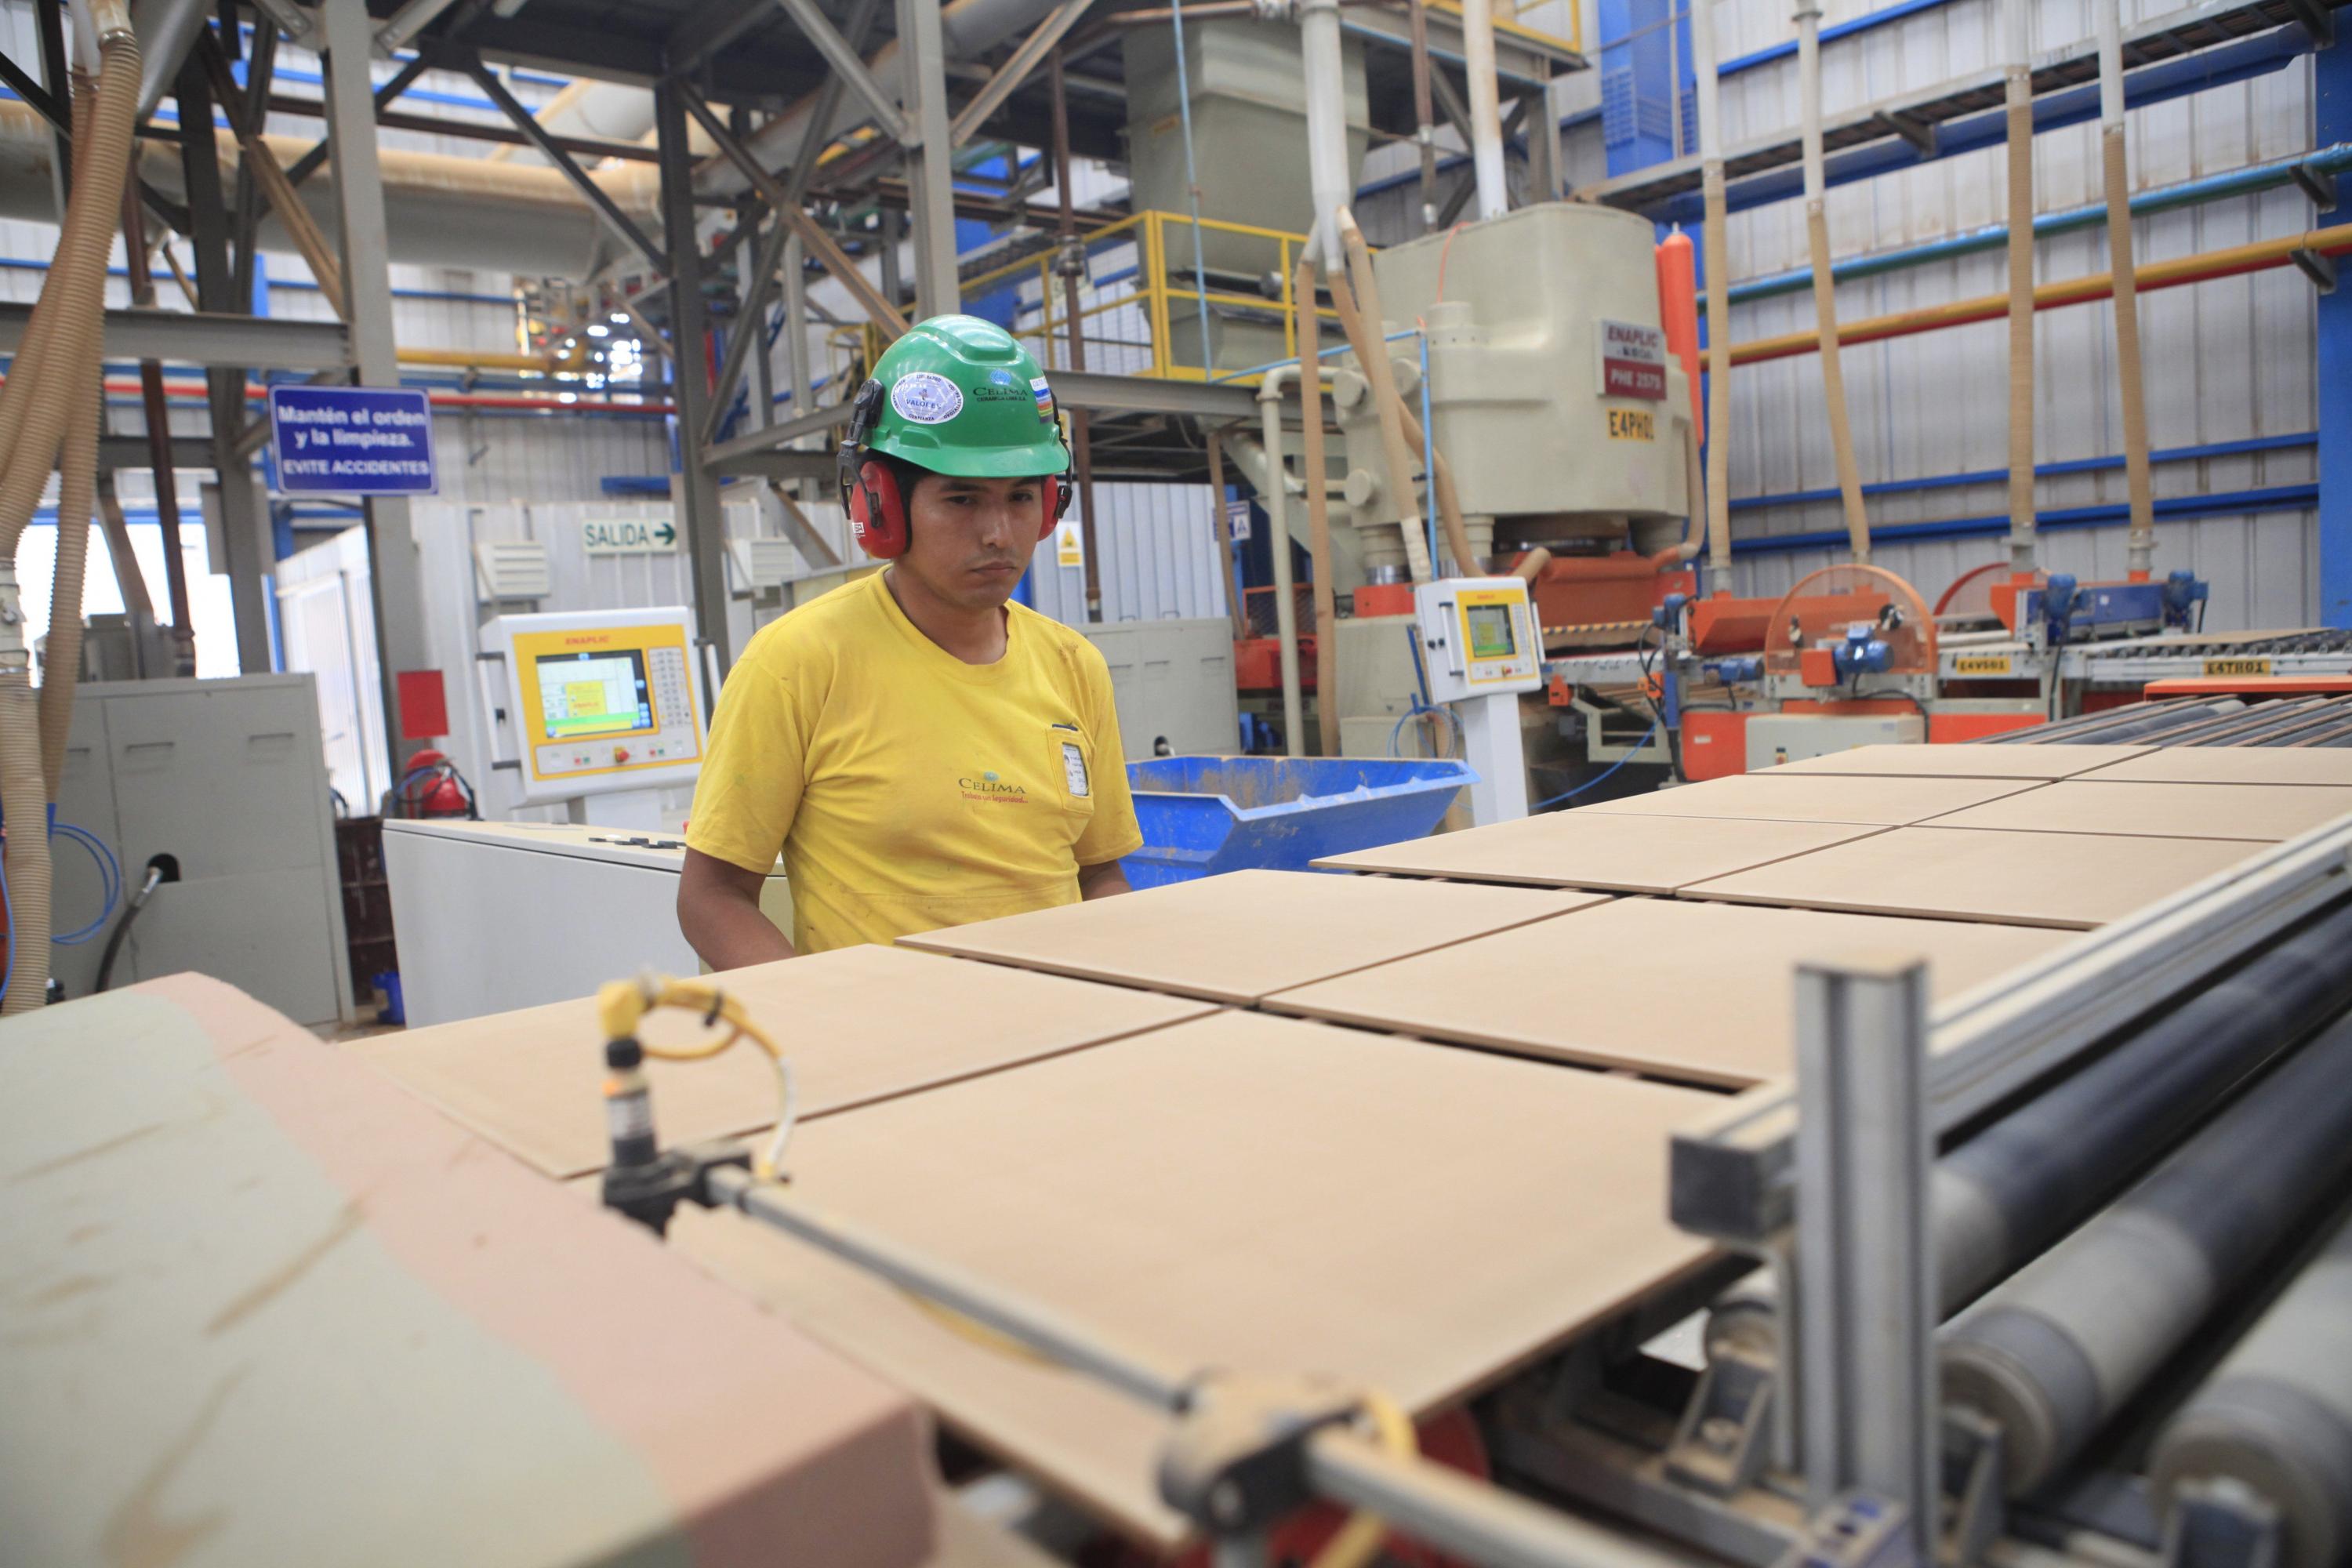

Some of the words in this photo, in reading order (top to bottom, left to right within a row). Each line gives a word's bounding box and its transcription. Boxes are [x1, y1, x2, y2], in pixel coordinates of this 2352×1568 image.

[1608, 325, 1658, 347] ENAPLIC
[278, 405, 349, 425] Mantén
[350, 408, 370, 425] el
[372, 408, 426, 426] orden
[294, 431, 307, 449] y
[310, 427, 330, 445] la
[332, 427, 415, 450] limpieza.
[283, 459, 330, 474] EVITE
[332, 459, 429, 475] ACCIDENTES
[584, 523, 651, 546] SALIDA
